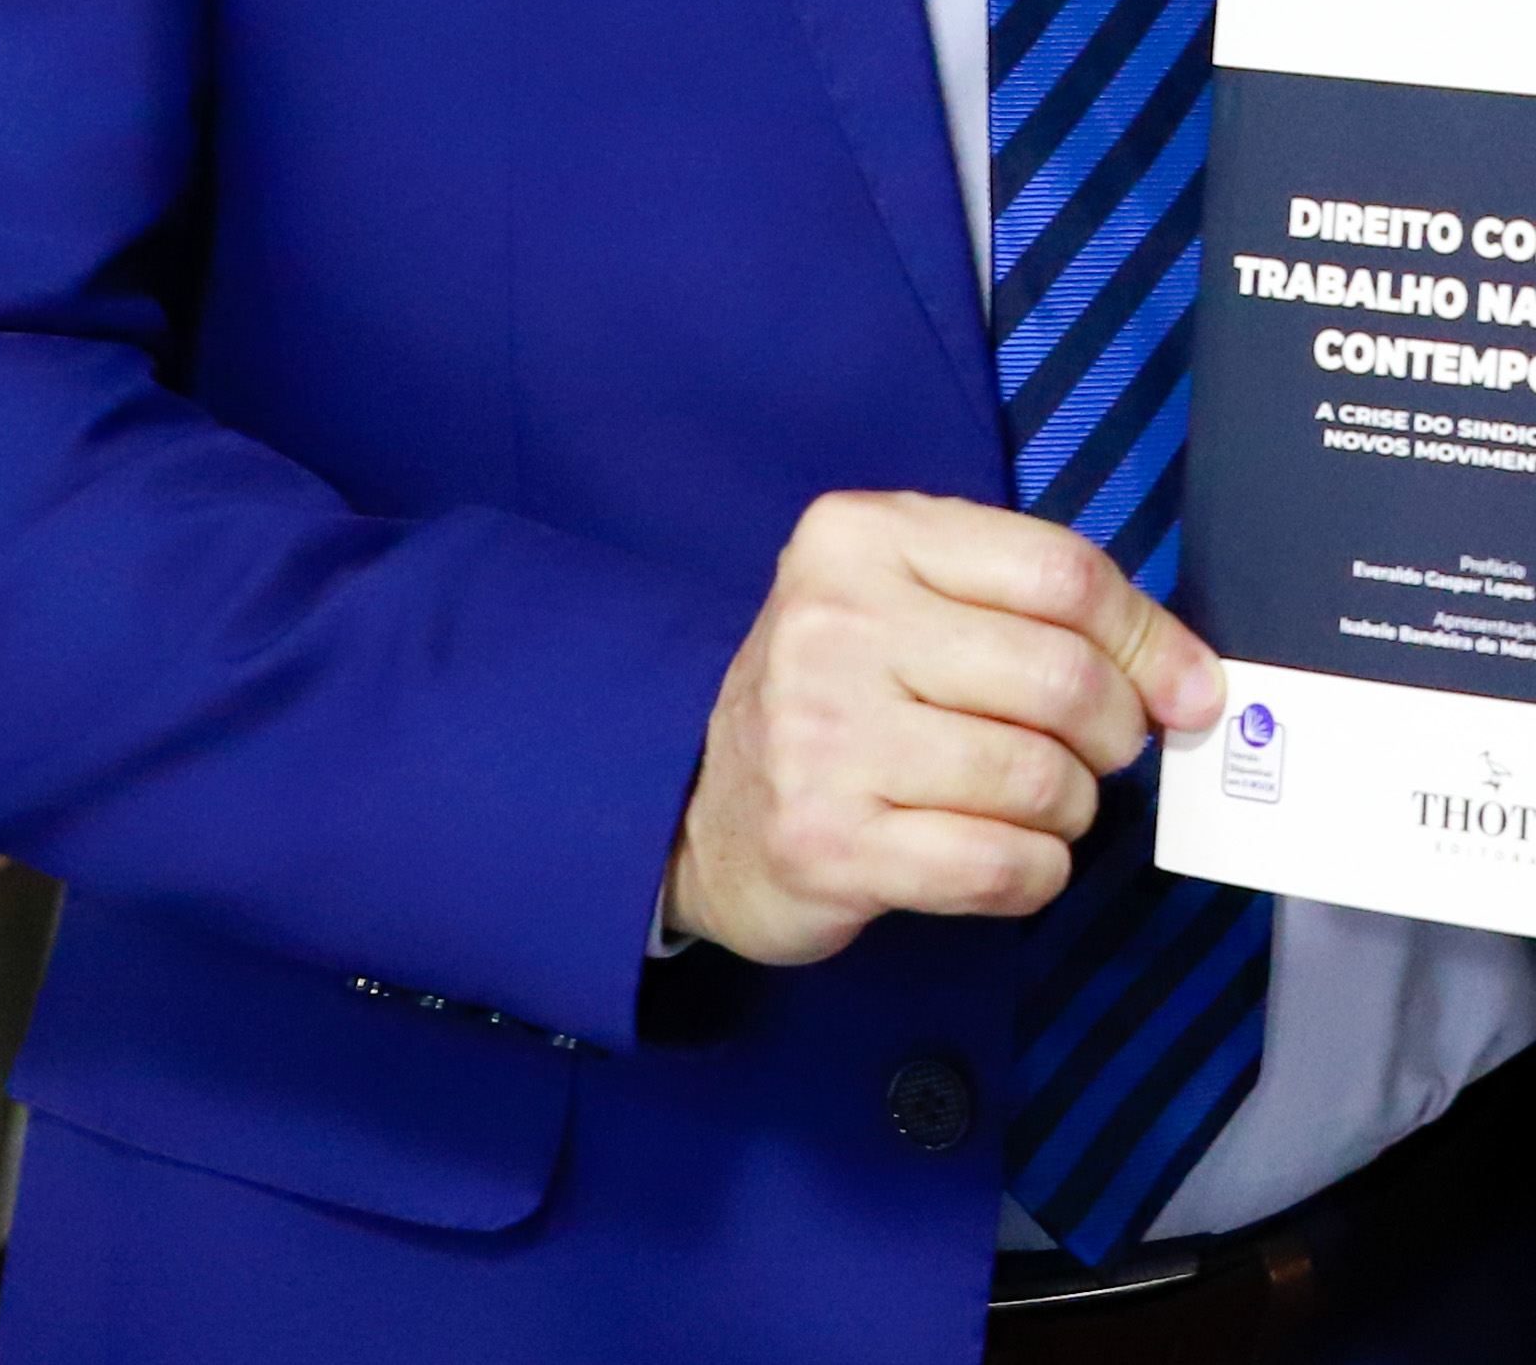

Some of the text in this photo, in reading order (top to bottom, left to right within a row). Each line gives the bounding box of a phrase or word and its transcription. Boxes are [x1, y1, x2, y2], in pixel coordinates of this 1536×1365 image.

[1288, 197, 1464, 254] DIREITO
[1233, 255, 1469, 320] TRABALHO
[1314, 402, 1336, 422] A
[1338, 404, 1410, 431] CRISE
[1413, 413, 1454, 436] DO
[1323, 428, 1411, 457] NOVOS
[1352, 560, 1424, 586] Everaldo
[1424, 569, 1483, 594] Gaspar
[1484, 577, 1536, 601] Lopes
[1459, 554, 1528, 580] Prefácio
[1398, 624, 1475, 651] Bandeira
[1474, 636, 1500, 656] de
